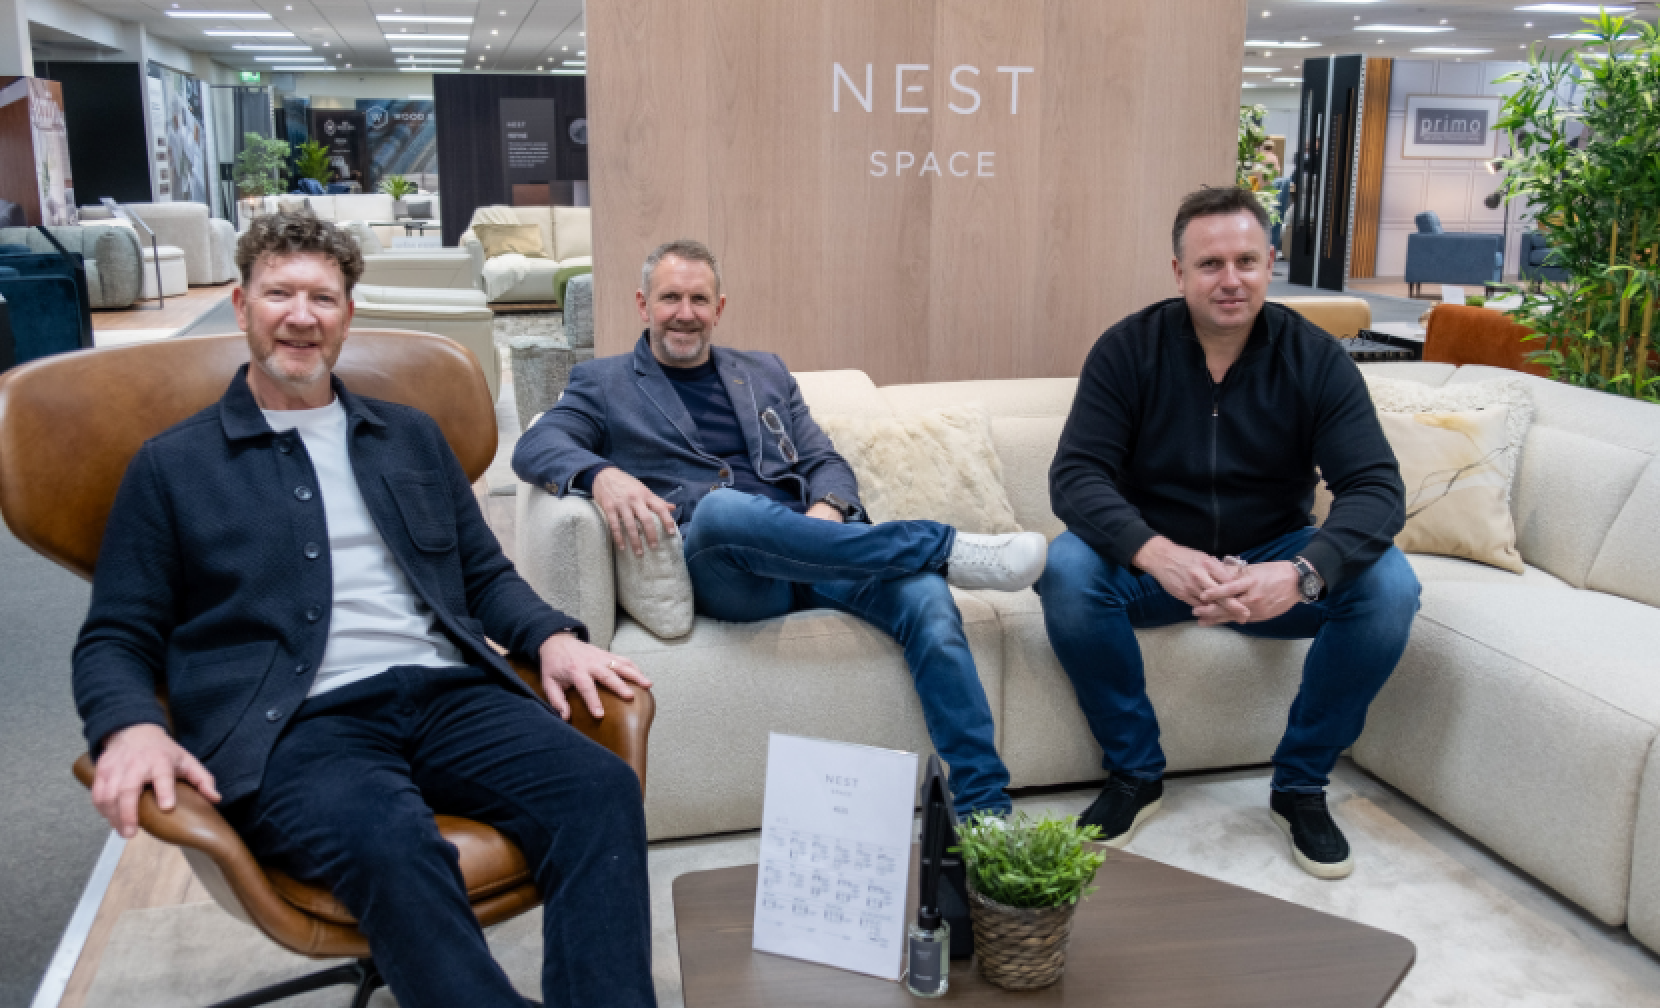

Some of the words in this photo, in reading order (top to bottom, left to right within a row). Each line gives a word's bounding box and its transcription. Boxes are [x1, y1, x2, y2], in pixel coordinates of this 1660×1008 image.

[832, 62, 1034, 115] NEST
[1420, 114, 1480, 136] primo
[869, 151, 996, 177] SPACE
[825, 774, 858, 788] NEST
